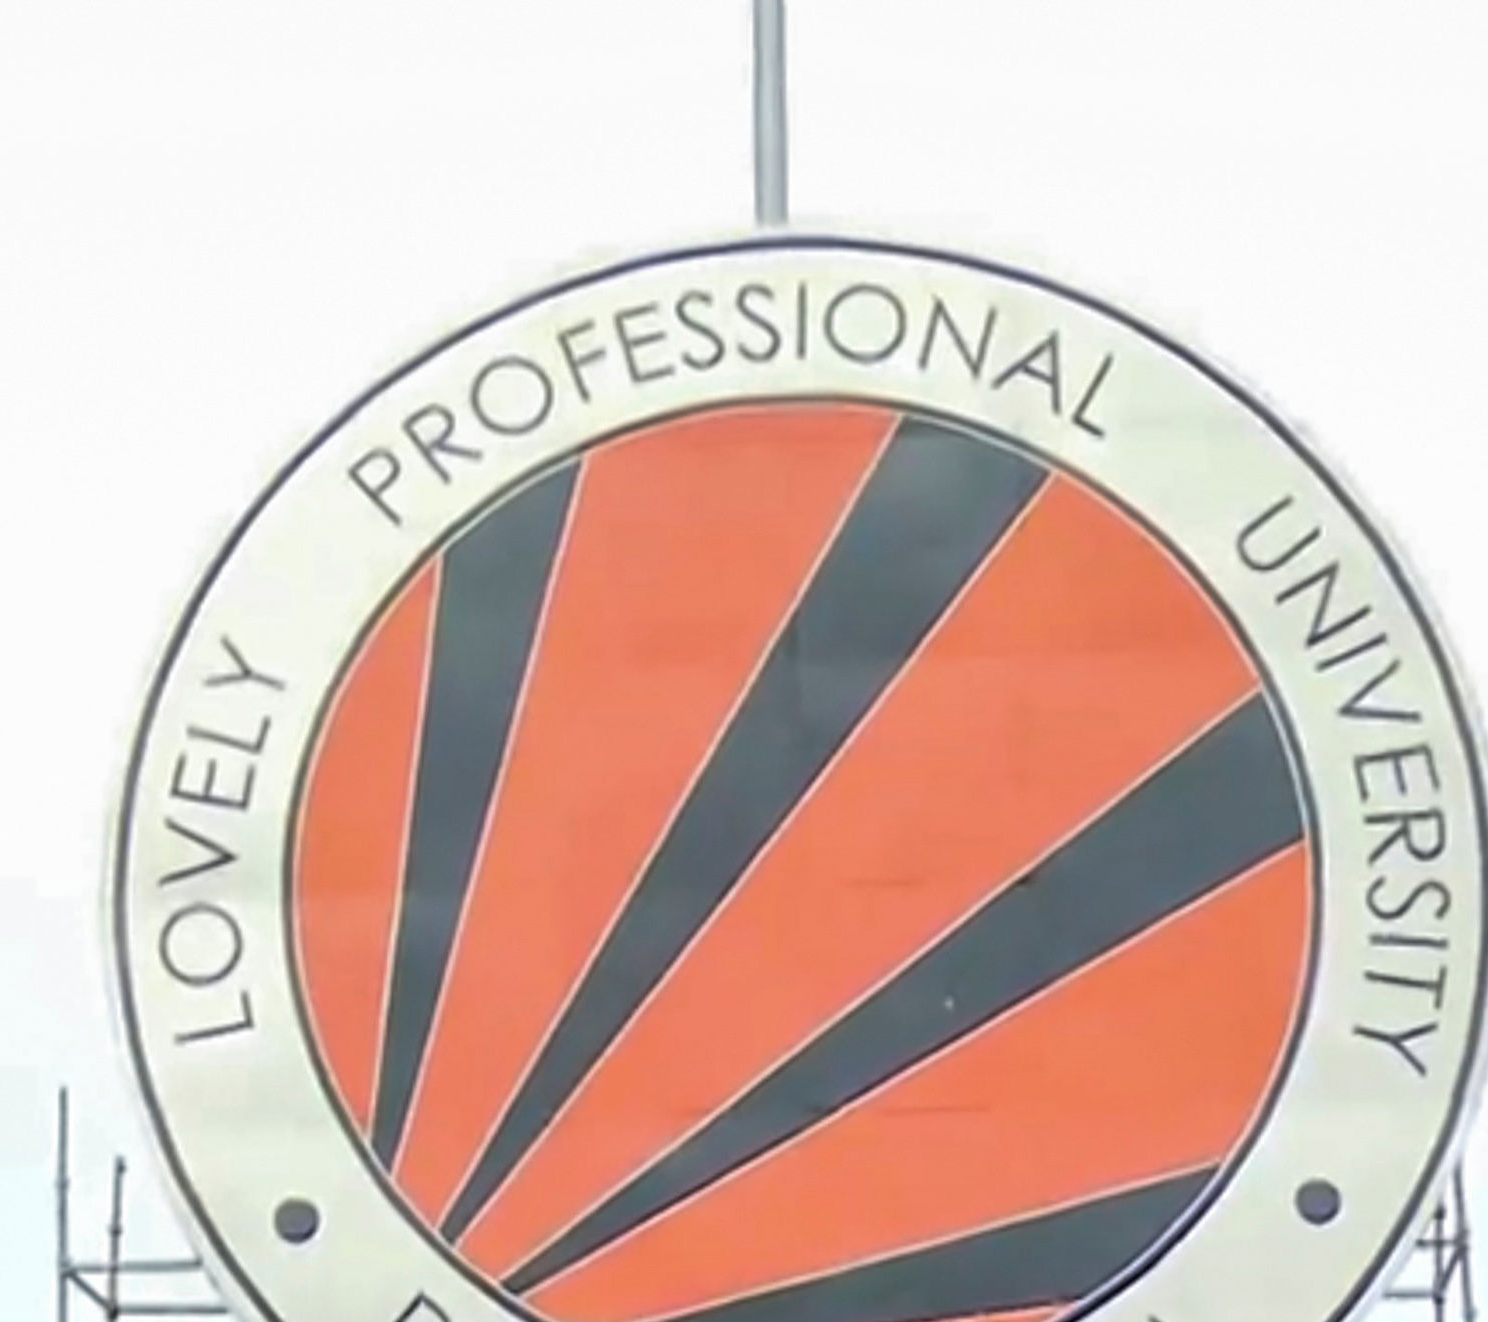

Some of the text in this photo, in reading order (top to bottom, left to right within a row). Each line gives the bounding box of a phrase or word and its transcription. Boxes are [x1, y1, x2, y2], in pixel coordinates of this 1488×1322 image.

[158, 283, 1452, 1076] LOVELY PROFESSIONAL UNIVERSITY
